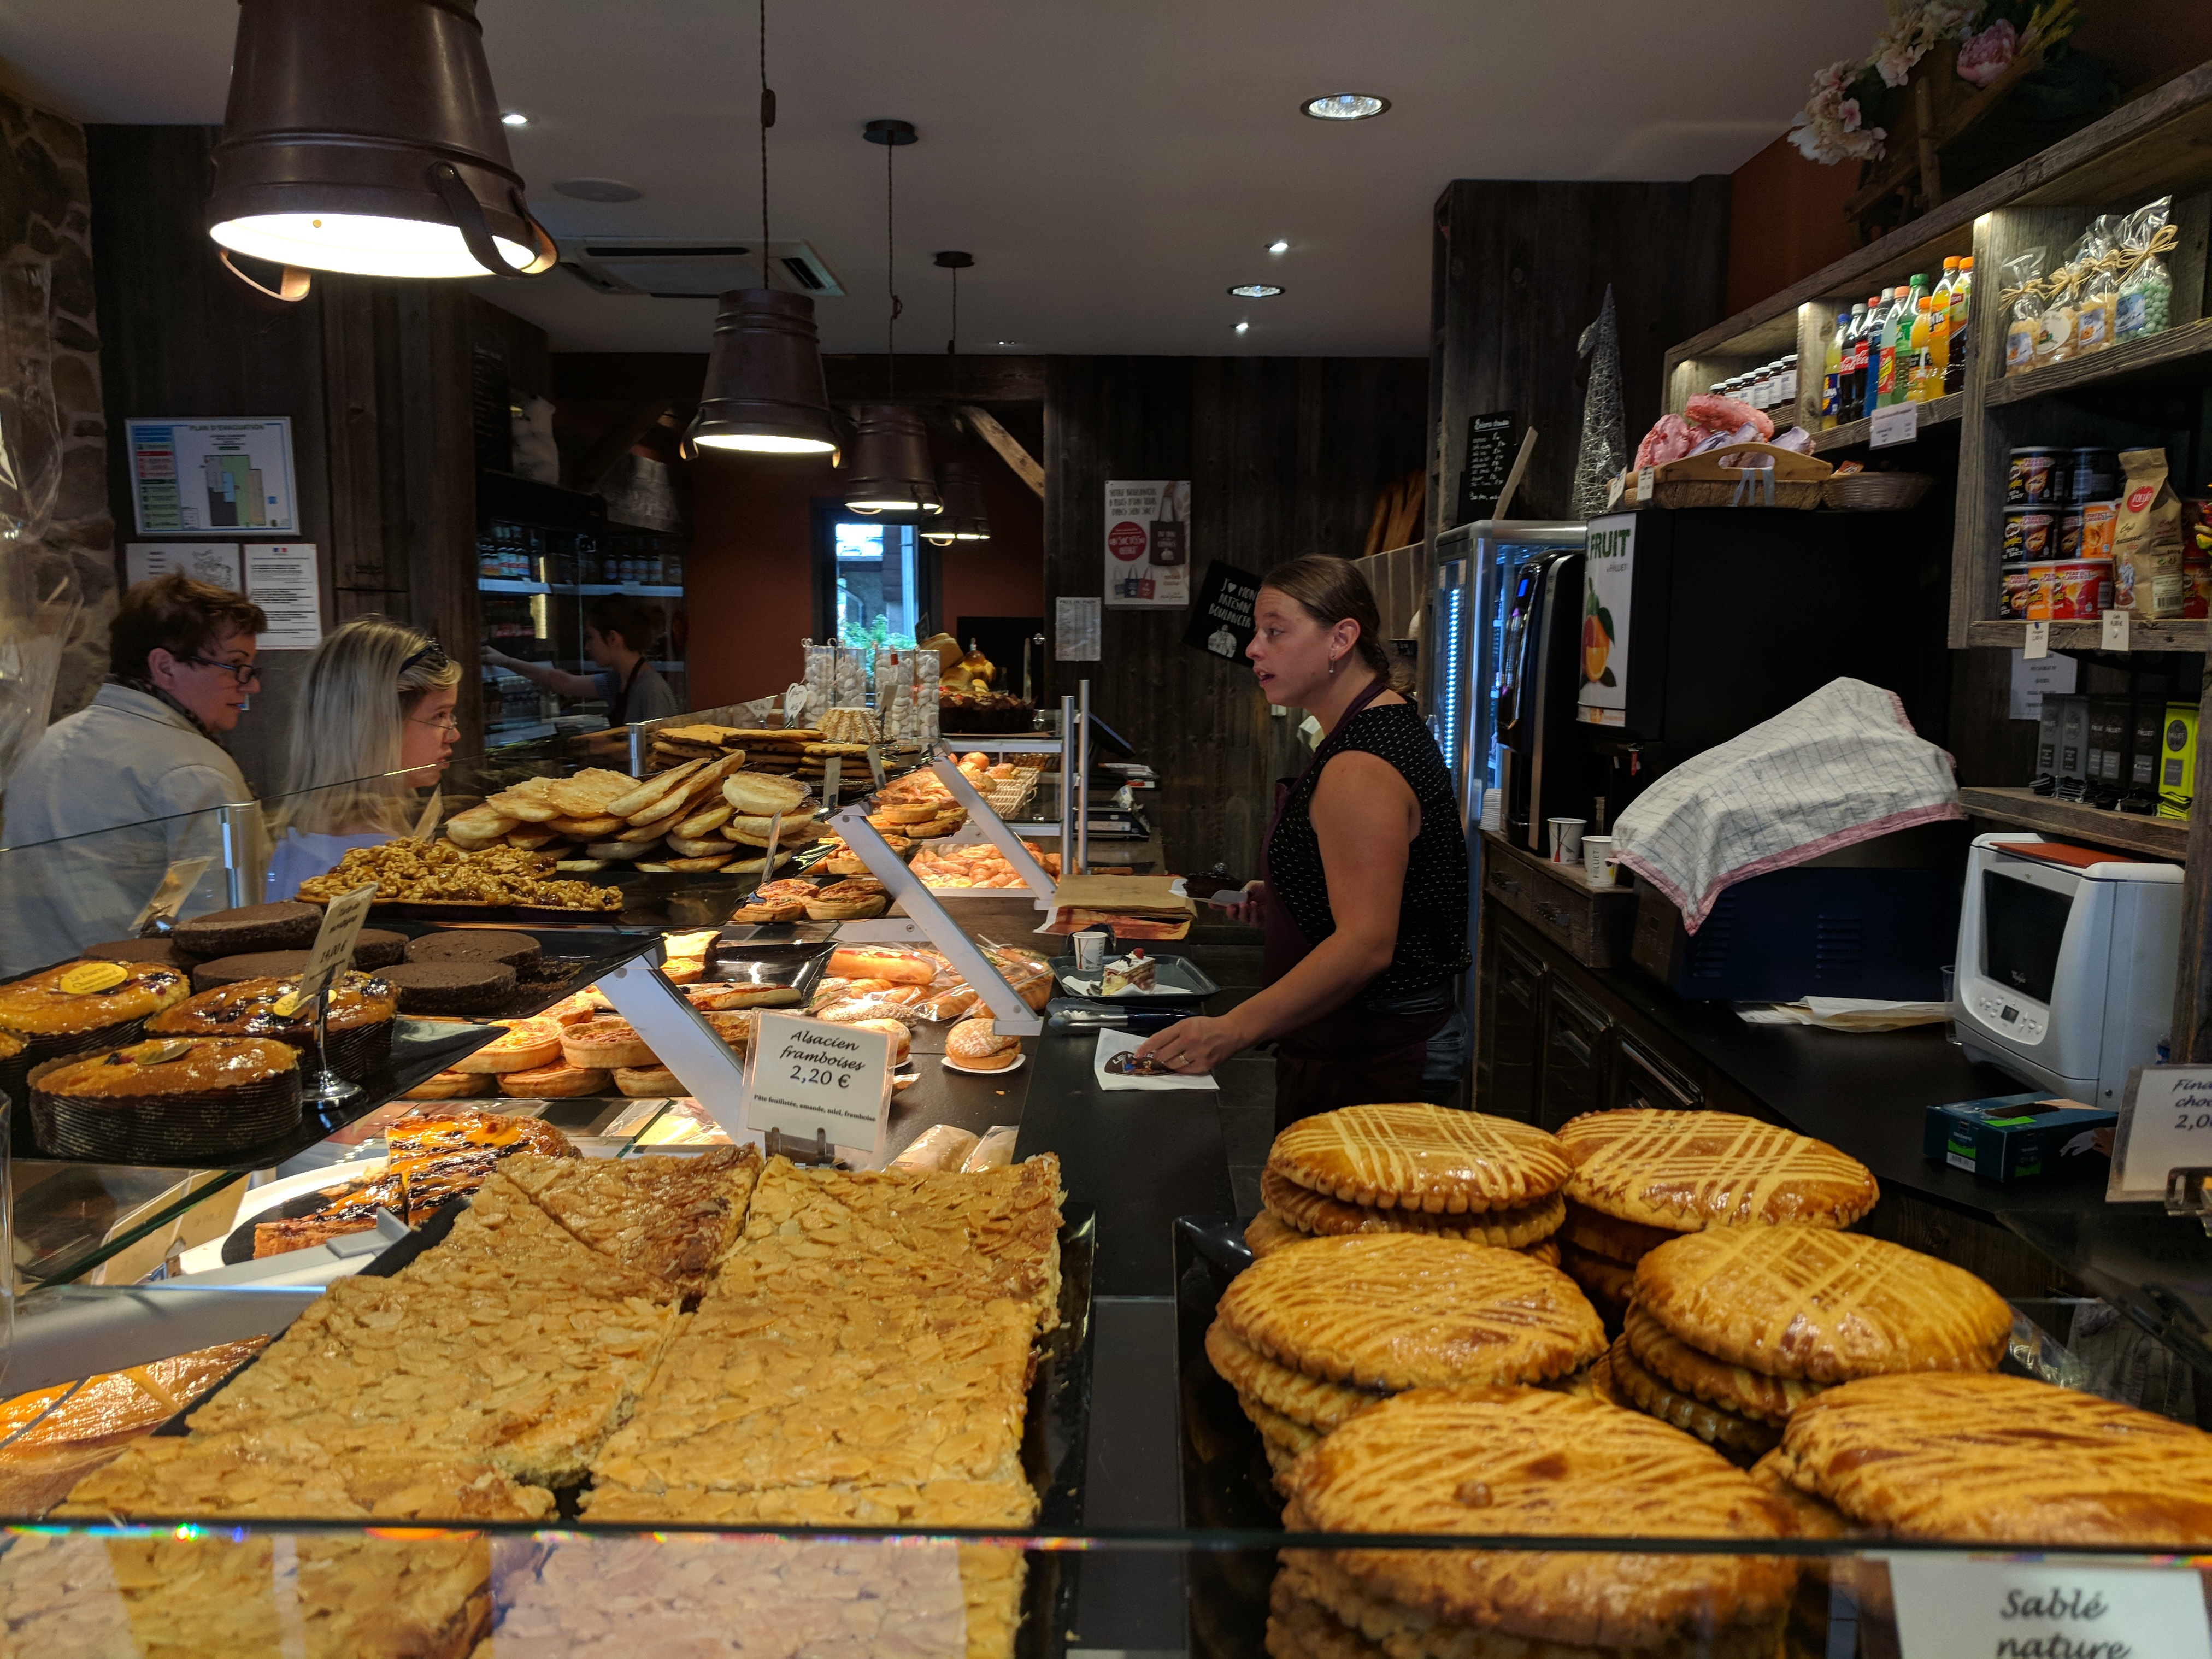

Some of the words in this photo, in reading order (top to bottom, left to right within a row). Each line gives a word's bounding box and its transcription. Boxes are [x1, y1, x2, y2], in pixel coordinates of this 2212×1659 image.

[1590, 529, 1631, 560] FRUIT
[791, 1030, 860, 1051] Alsacien
[779, 1045, 866, 1071] framboises
[790, 1065, 832, 1085] 2,20
[838, 1073, 851, 1089] €
[799, 1103, 826, 1113] amande,
[827, 1109, 843, 1117] miel,
[844, 1111, 876, 1122] framboise
[2000, 1588, 2108, 1621] Sablé
[1995, 1632, 2132, 1659] nature
